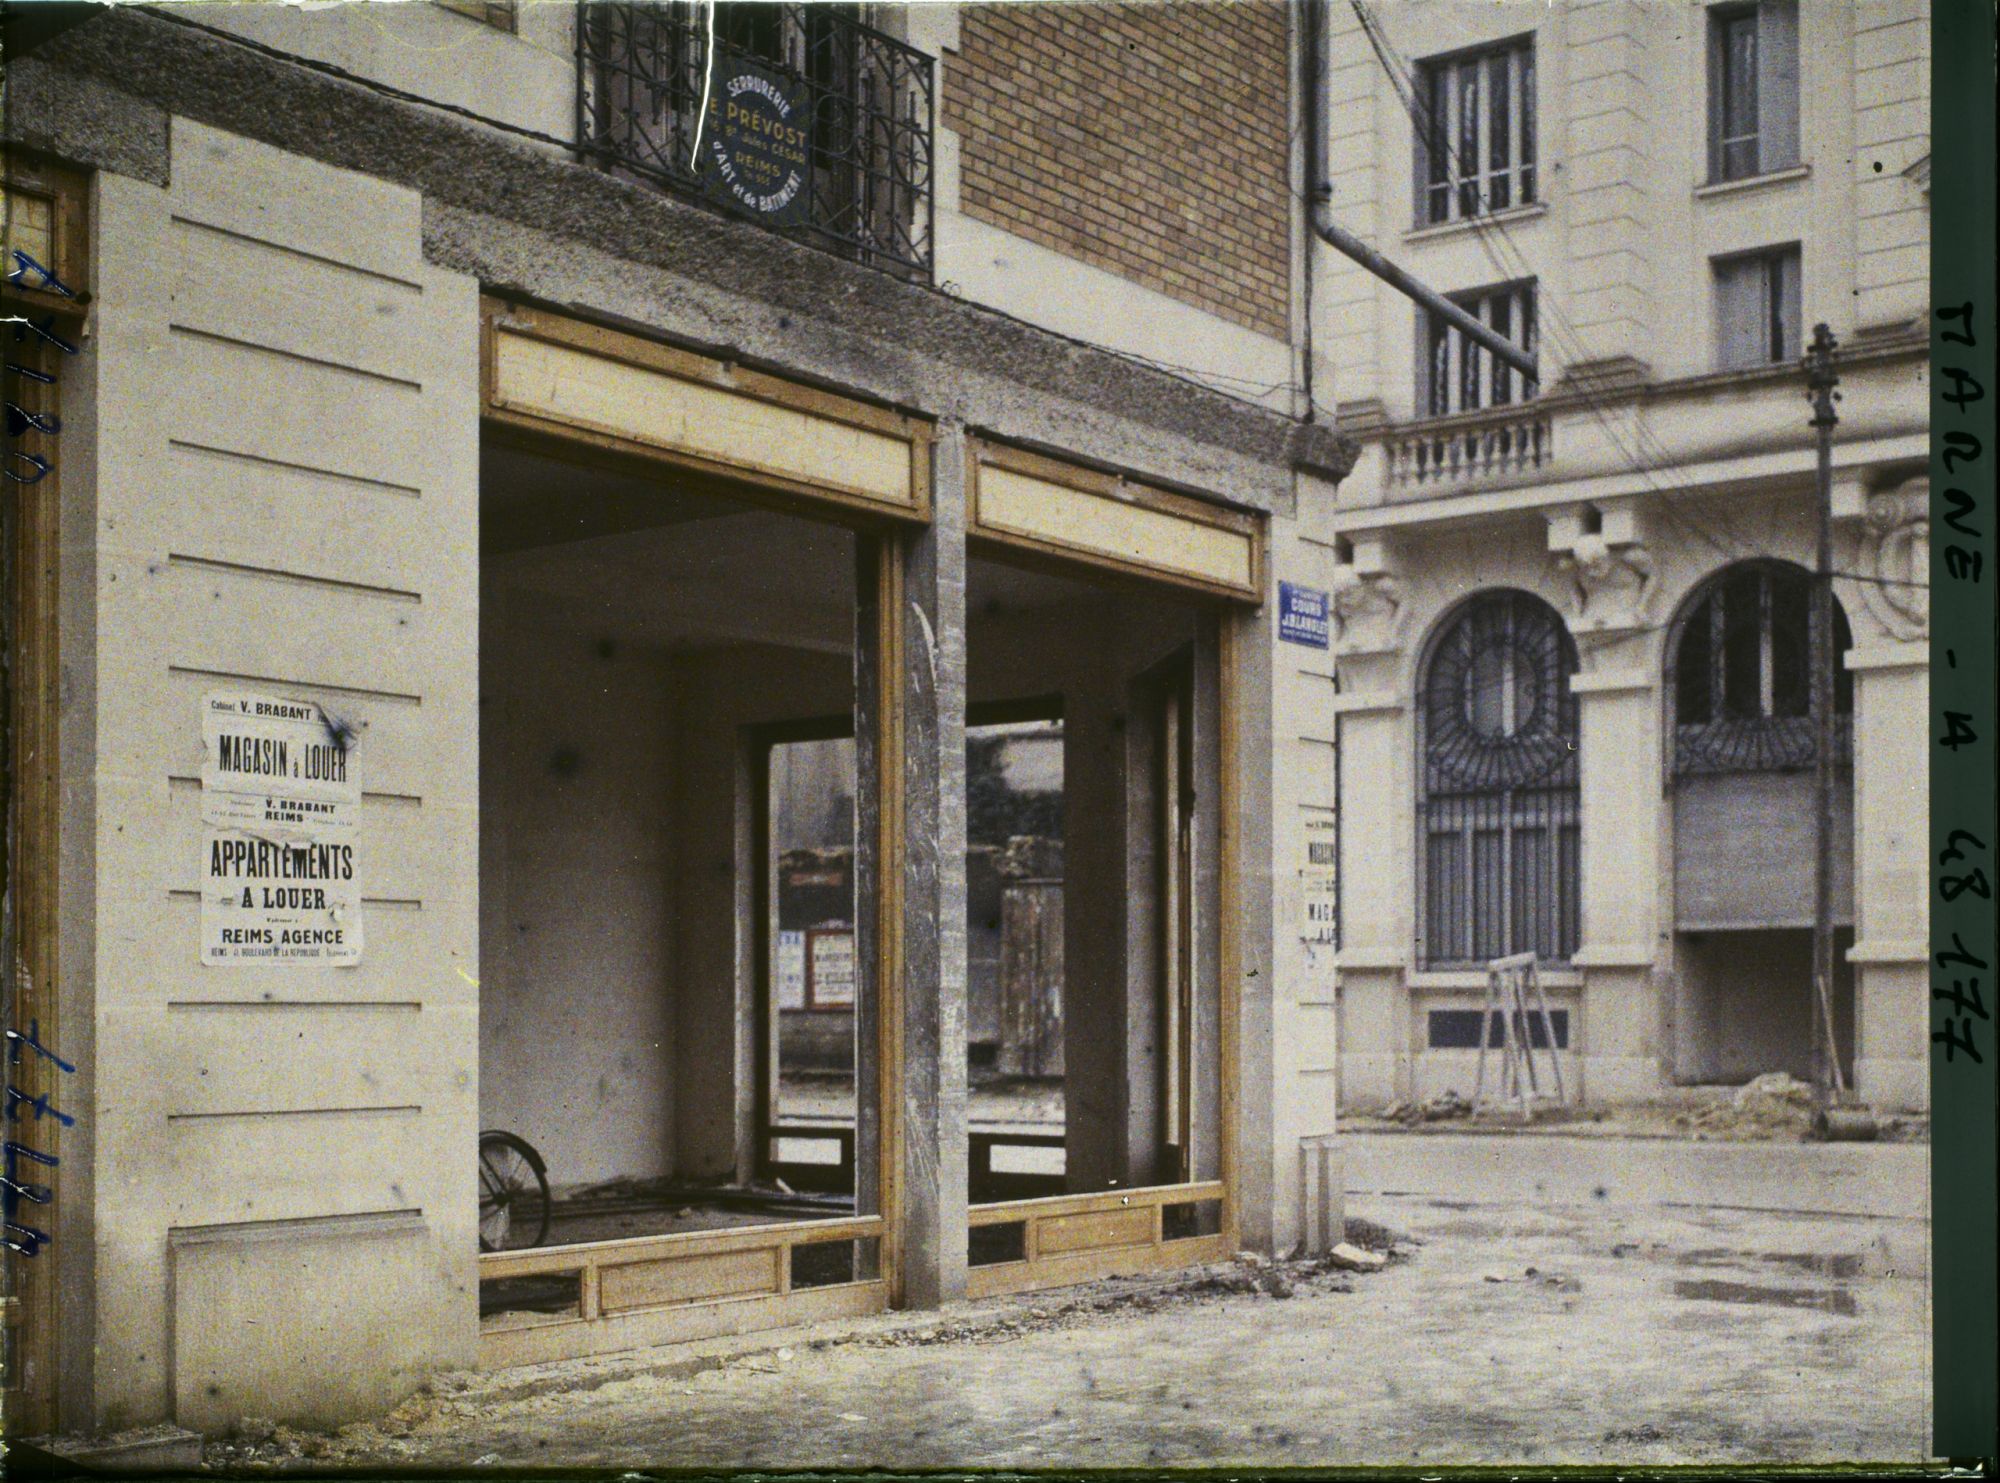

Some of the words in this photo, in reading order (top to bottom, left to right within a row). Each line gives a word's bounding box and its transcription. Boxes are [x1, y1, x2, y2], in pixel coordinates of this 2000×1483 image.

[727, 75, 791, 119] SERRURERIE
[727, 102, 807, 148] PRÉVOST
[735, 151, 781, 178] REIMS
[1935, 301, 1985, 584] MARNE
[240, 700, 251, 714] V.
[256, 702, 312, 720] BRABANT
[219, 734, 287, 777] MAGASIN
[293, 757, 299, 778] à
[305, 743, 347, 782] LOUER
[265, 799, 276, 809] V.
[280, 800, 336, 814] BRABANT
[265, 811, 304, 823] REIMS
[211, 840, 353, 880] APPARTEMENTS
[241, 886, 254, 908] A
[263, 887, 326, 910] LOUER
[222, 928, 273, 944] REIMS
[281, 929, 344, 945] AGENCE
